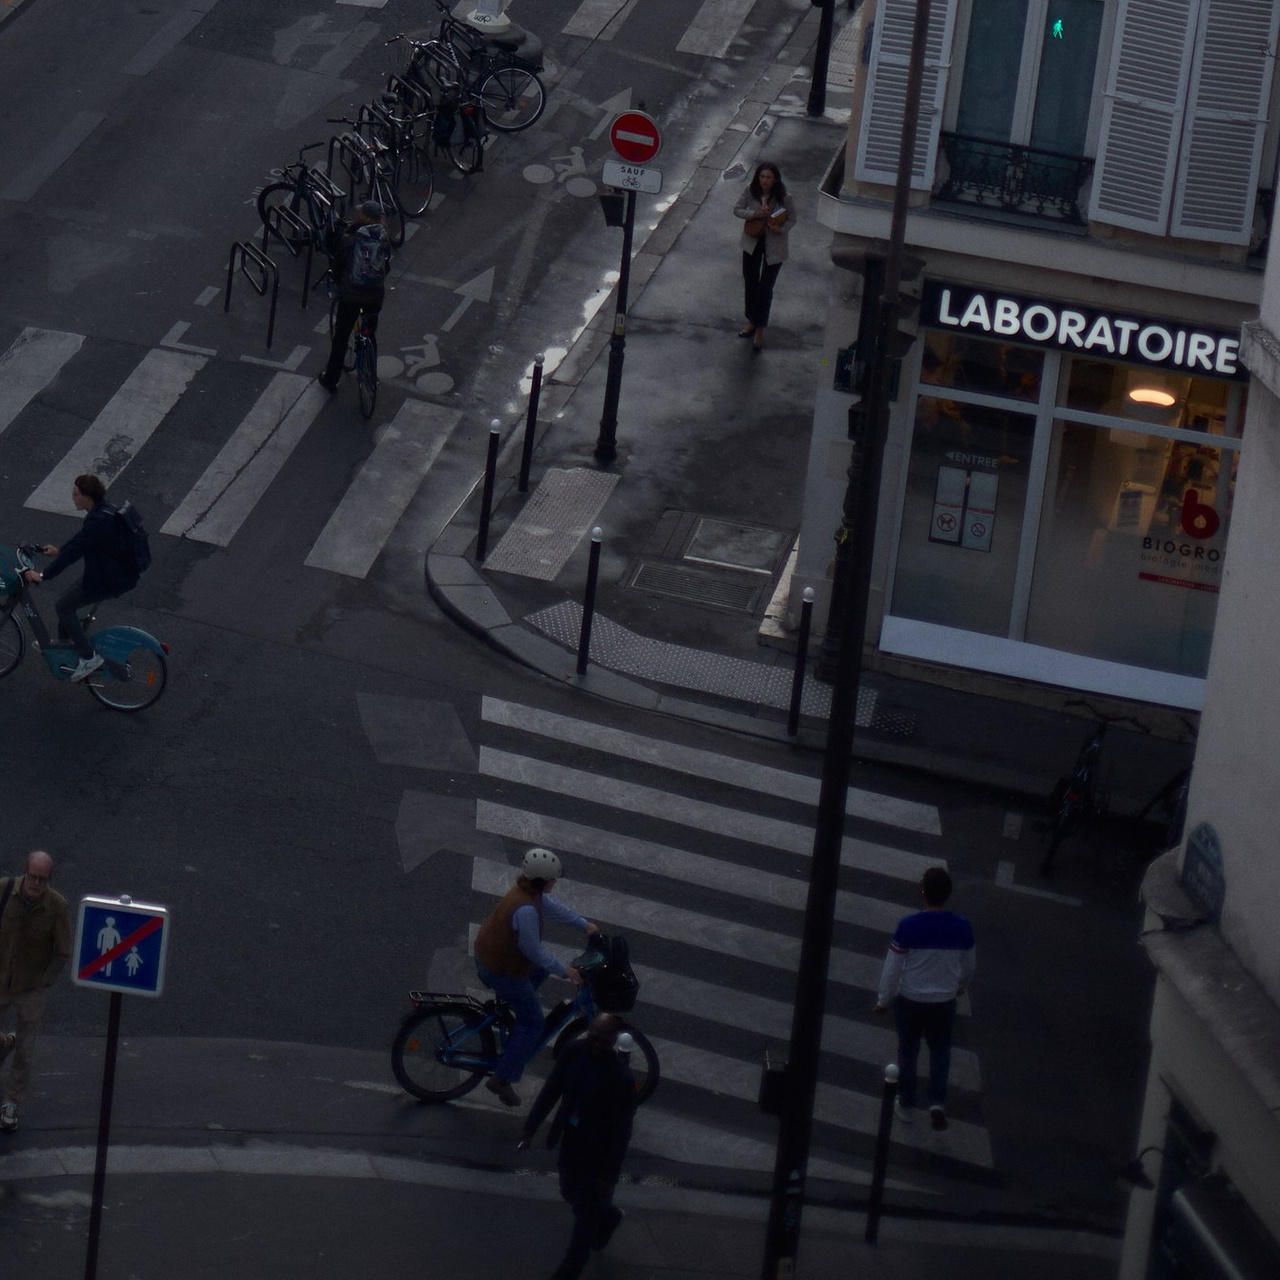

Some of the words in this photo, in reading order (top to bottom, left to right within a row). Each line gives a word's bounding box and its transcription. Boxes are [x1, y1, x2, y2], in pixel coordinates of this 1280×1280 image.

[621, 166, 645, 176] SAUF
[938, 289, 1240, 374] LABORATOIRE
[956, 452, 998, 468] ENTREE
[1143, 536, 1220, 562] BIOGRO
